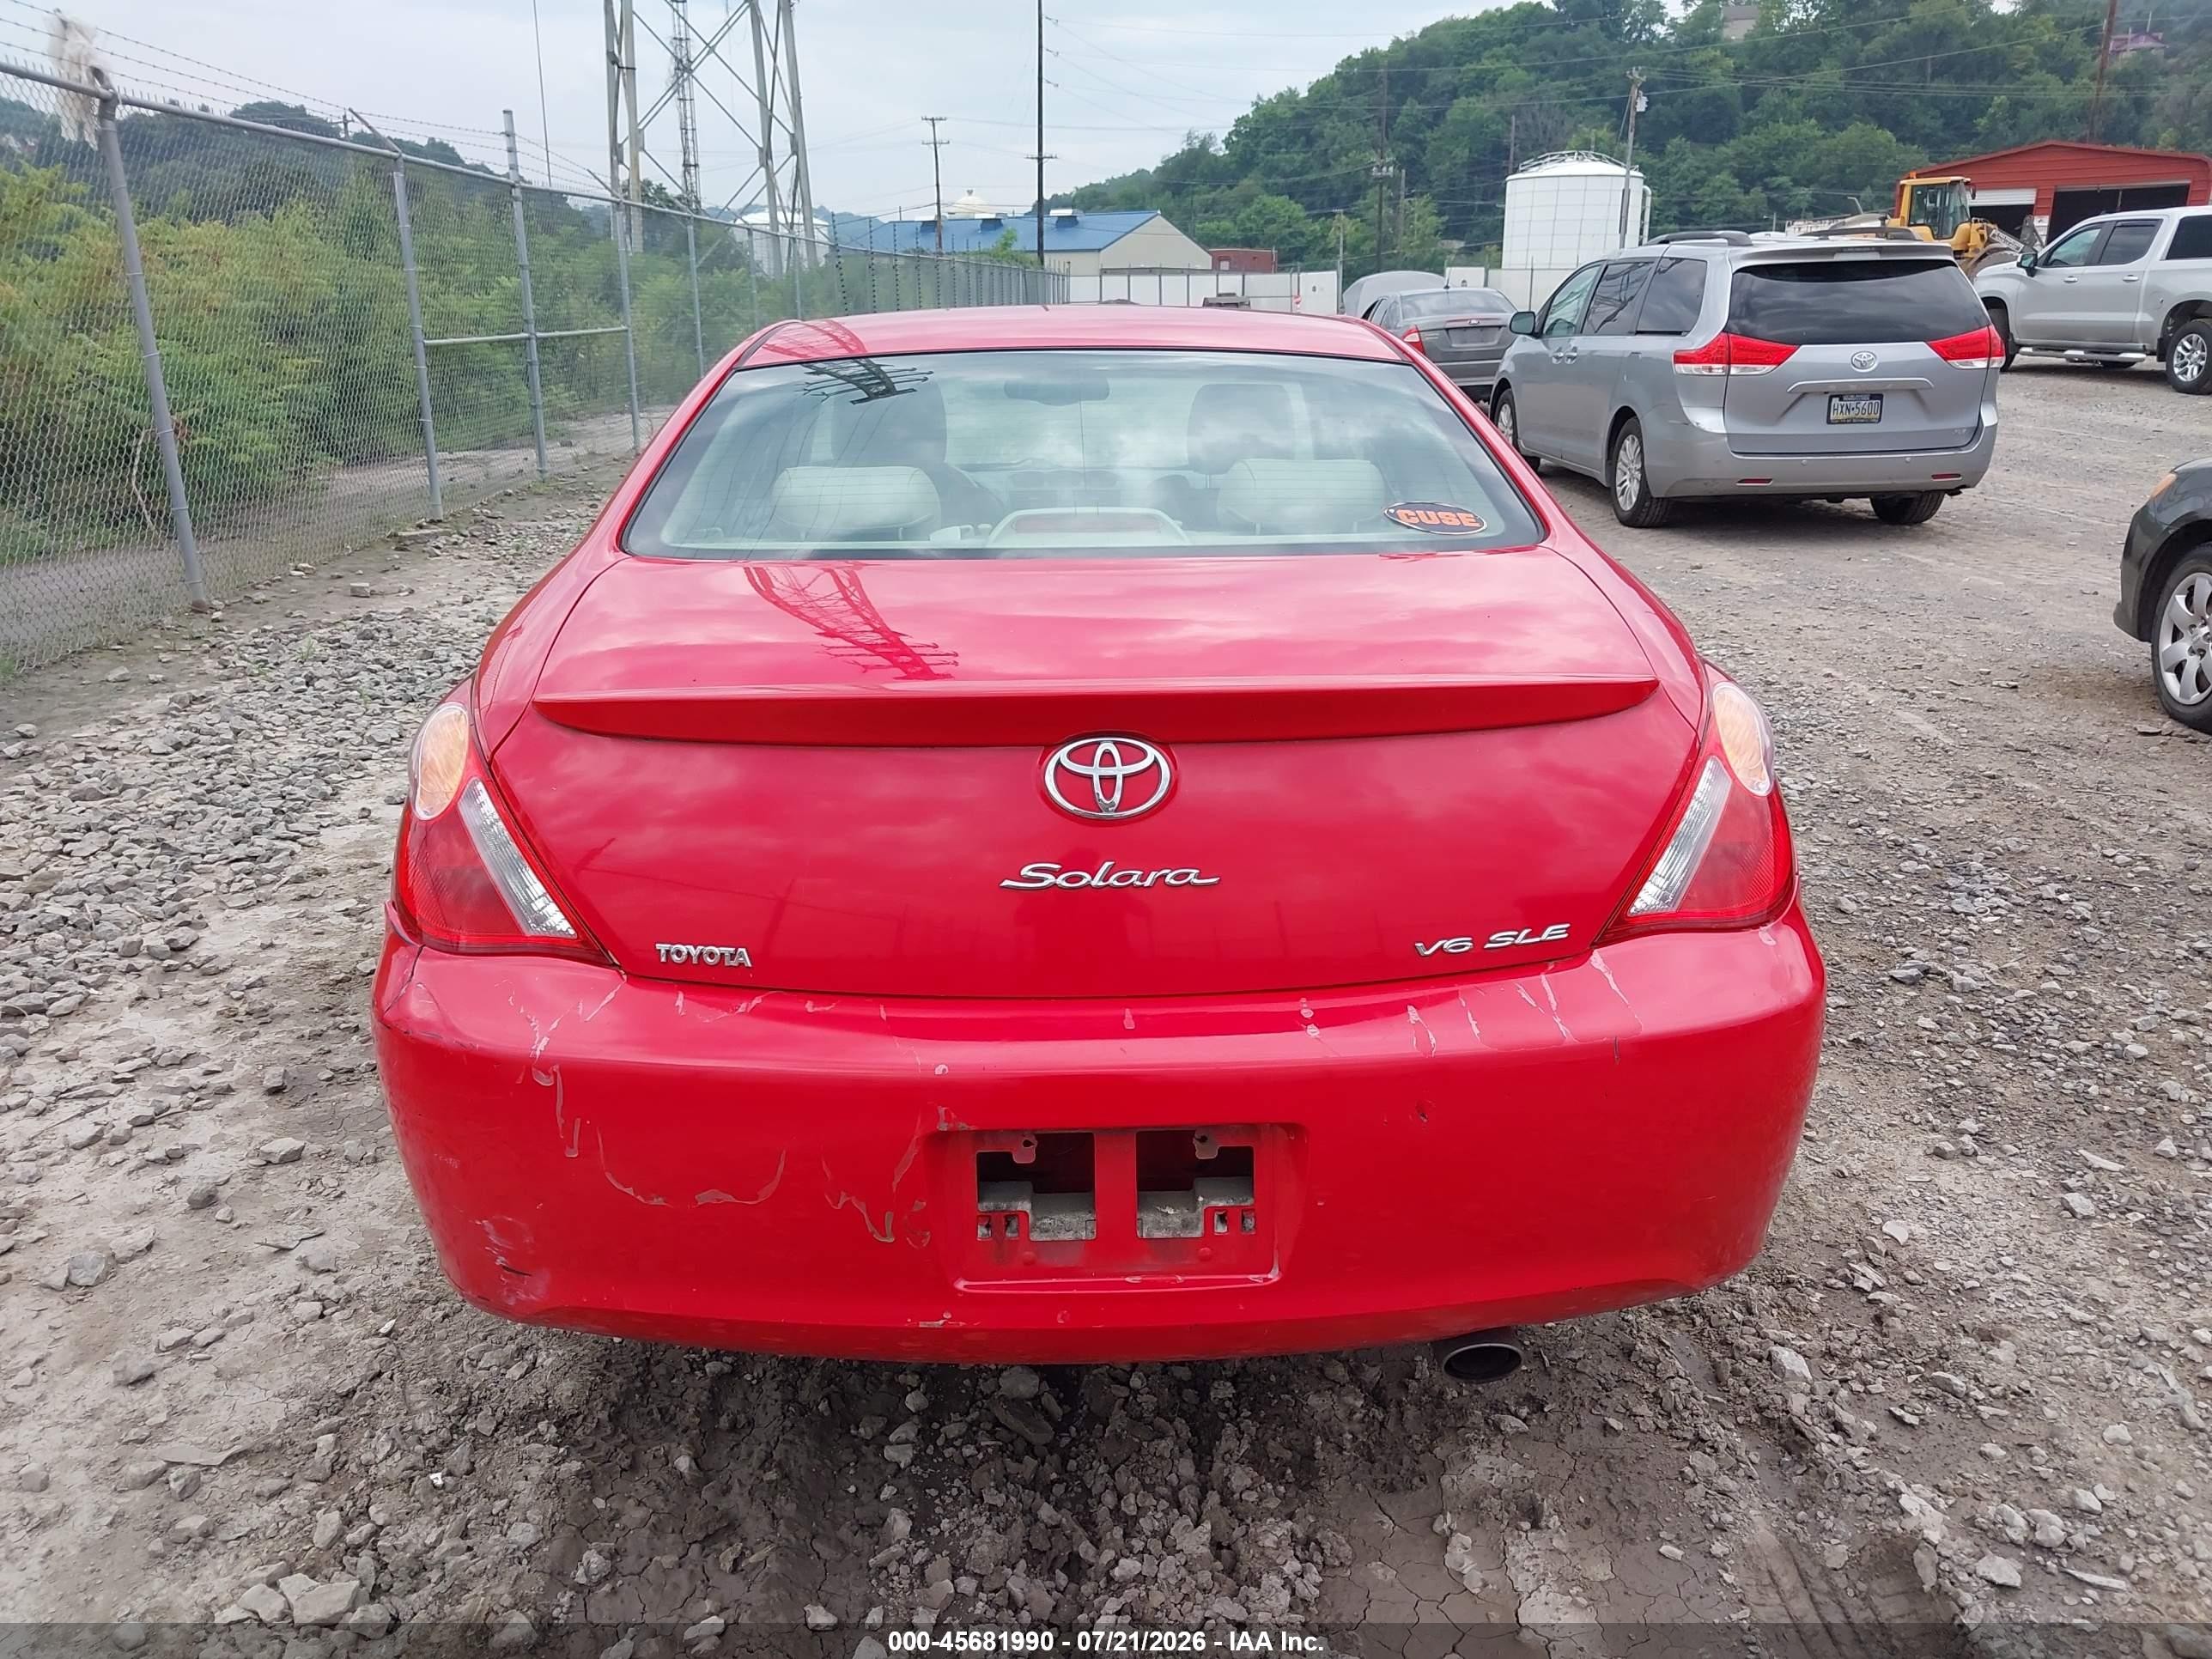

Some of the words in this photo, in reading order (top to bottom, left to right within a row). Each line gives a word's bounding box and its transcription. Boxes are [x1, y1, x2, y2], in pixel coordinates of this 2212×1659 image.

[1000, 860, 1220, 890] Solara
[655, 943, 752, 967] TOYOTA
[1415, 937, 1474, 957] V6
[1483, 923, 1571, 950] SLE
